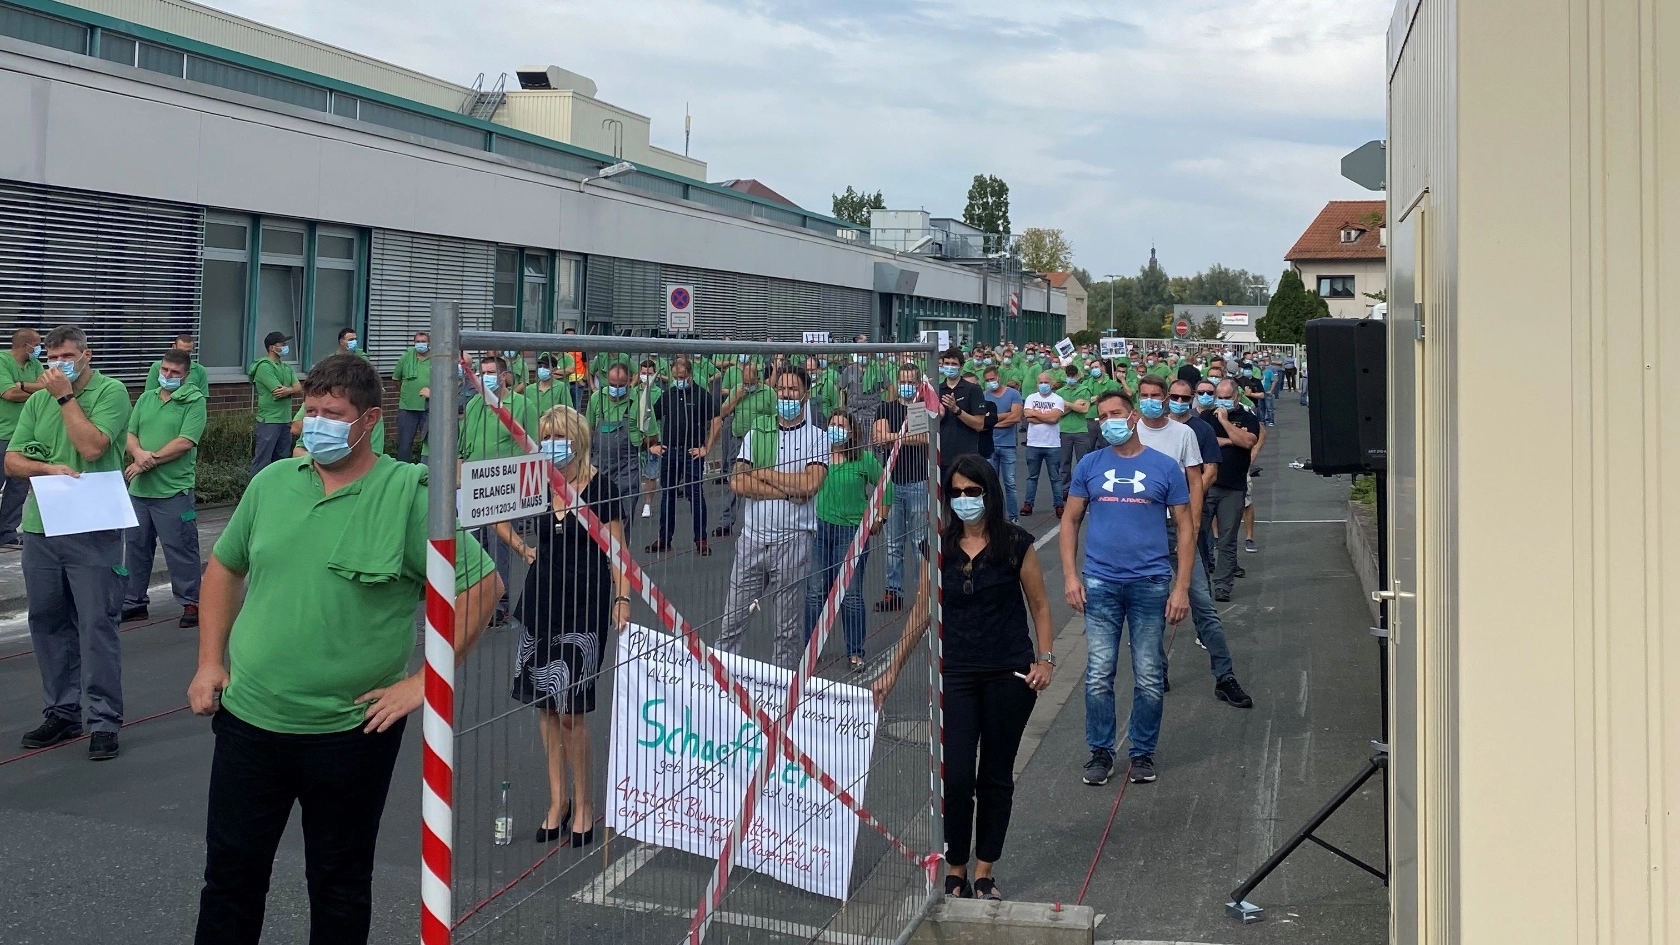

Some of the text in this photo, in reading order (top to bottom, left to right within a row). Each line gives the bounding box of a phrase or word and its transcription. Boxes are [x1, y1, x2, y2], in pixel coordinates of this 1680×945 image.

[471, 463, 518, 481] MAUSS BAU
[473, 483, 516, 499] ERLANGEN
[471, 501, 517, 518] 09131/1203-0
[521, 495, 543, 509] MAUSS
[647, 667, 683, 685] Alter
[691, 681, 714, 693] von
[618, 805, 647, 820] eine
[655, 811, 705, 837] Spende
[684, 796, 734, 828] Blumen
